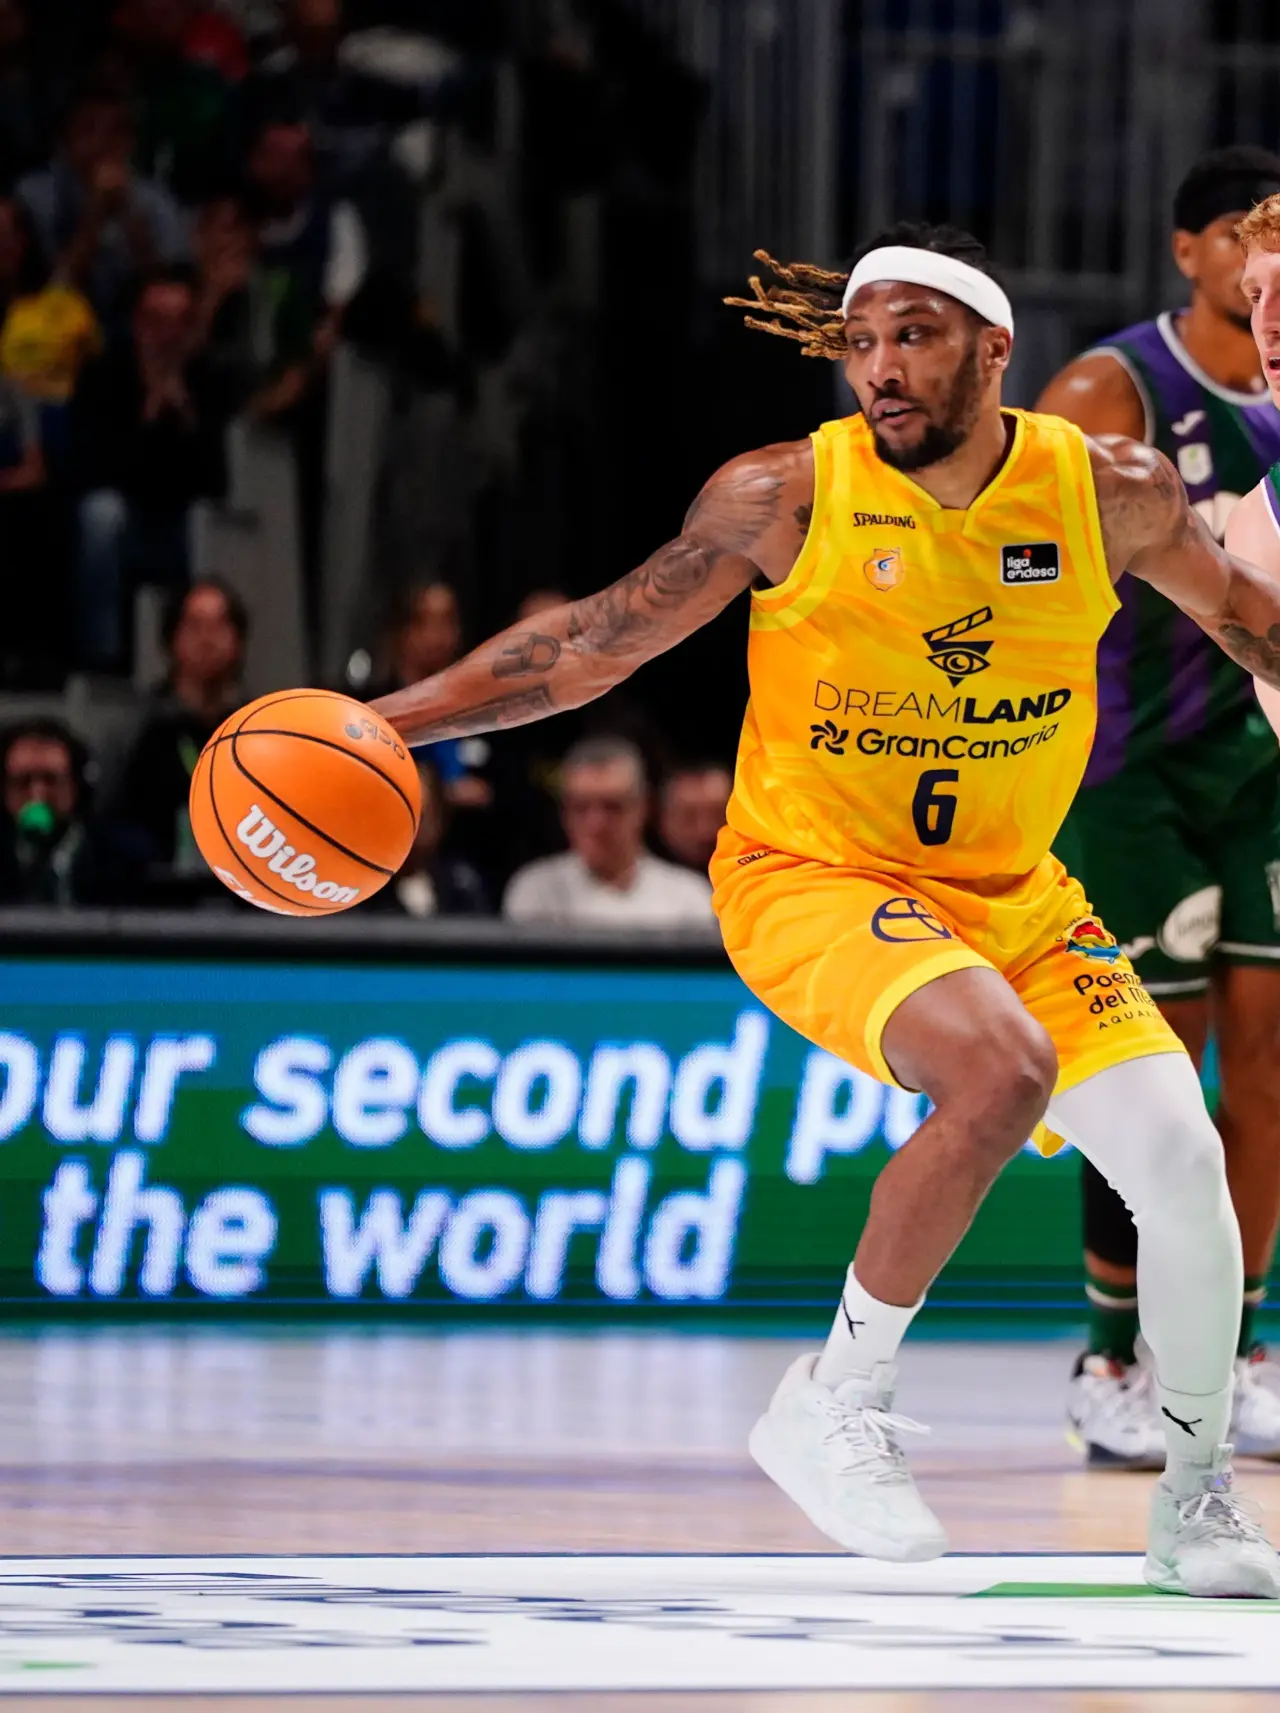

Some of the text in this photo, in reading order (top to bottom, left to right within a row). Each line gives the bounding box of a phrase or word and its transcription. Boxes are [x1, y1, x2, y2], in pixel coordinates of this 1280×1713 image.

[853, 512, 916, 529] SPALDING
[1006, 556, 1030, 569] liga
[1006, 567, 1057, 580] endesa
[814, 679, 1072, 724] DREAMLAND
[856, 722, 1060, 760] GranCanaria
[912, 768, 960, 846] 6
[236, 803, 361, 904] Wilson
[1088, 988, 1128, 1014] del
[241, 1010, 770, 1148] second
[37, 1151, 747, 1300] the world
